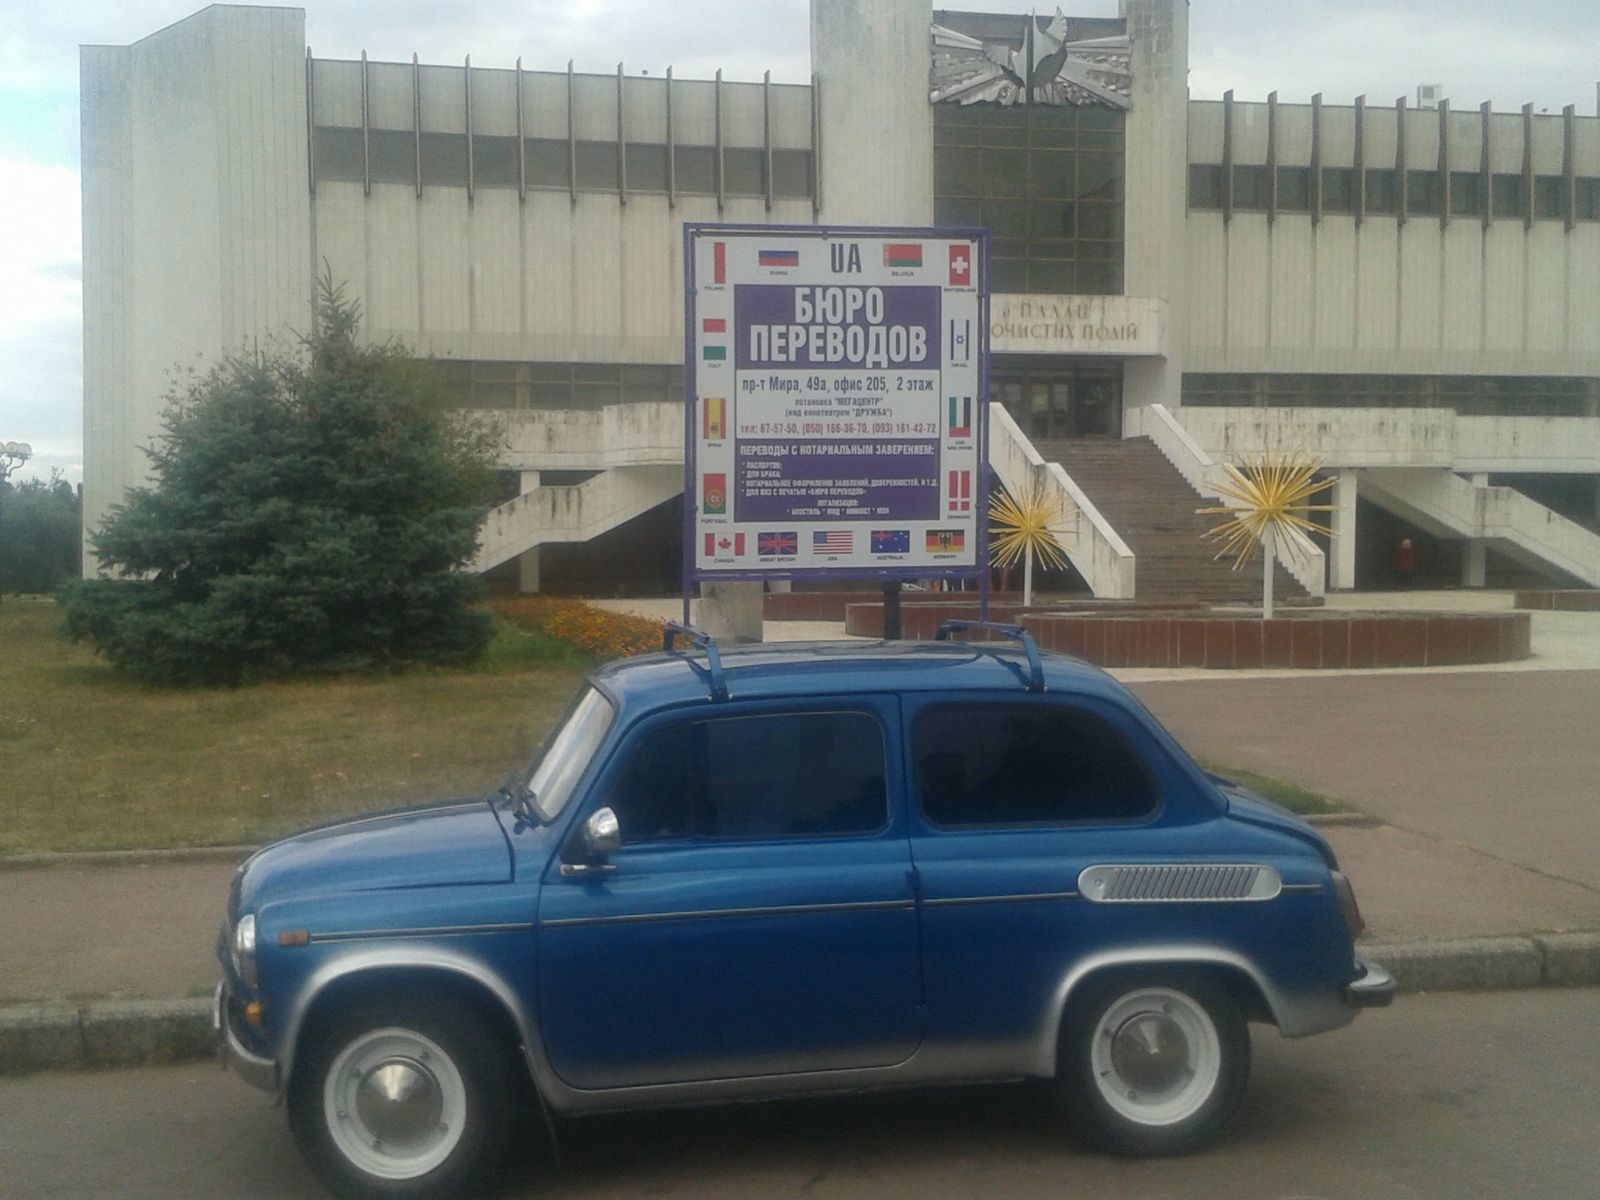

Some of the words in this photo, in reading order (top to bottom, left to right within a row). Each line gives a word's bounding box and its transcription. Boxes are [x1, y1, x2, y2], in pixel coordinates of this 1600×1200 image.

[831, 243, 861, 273] UA
[795, 287, 884, 324] БЮРО
[750, 325, 927, 368] ПЕРЕВОДОВ
[742, 378, 764, 394] пр-т
[769, 376, 802, 394] Мира,
[806, 376, 830, 393] 49а,
[834, 376, 862, 394] офис
[866, 377, 889, 393] 205,
[897, 377, 902, 390] 2
[907, 379, 934, 391] этаж
[834, 397, 883, 407] "МЕГАЦЕНТР"
[785, 409, 801, 418] (над
[804, 409, 850, 417] кинотеатром
[851, 408, 892, 418] "ДРУЖБА")
[741, 424, 758, 434] тел:
[802, 423, 823, 435] (050)
[872, 423, 893, 435] (093)
[740, 445, 789, 456] ПЕРЕВОДЫ
[791, 445, 797, 455] С
[800, 444, 873, 455] НОТАРИАЛЬНЫМ
[875, 444, 934, 455] ЗАВЕРЕНИЕМ:
